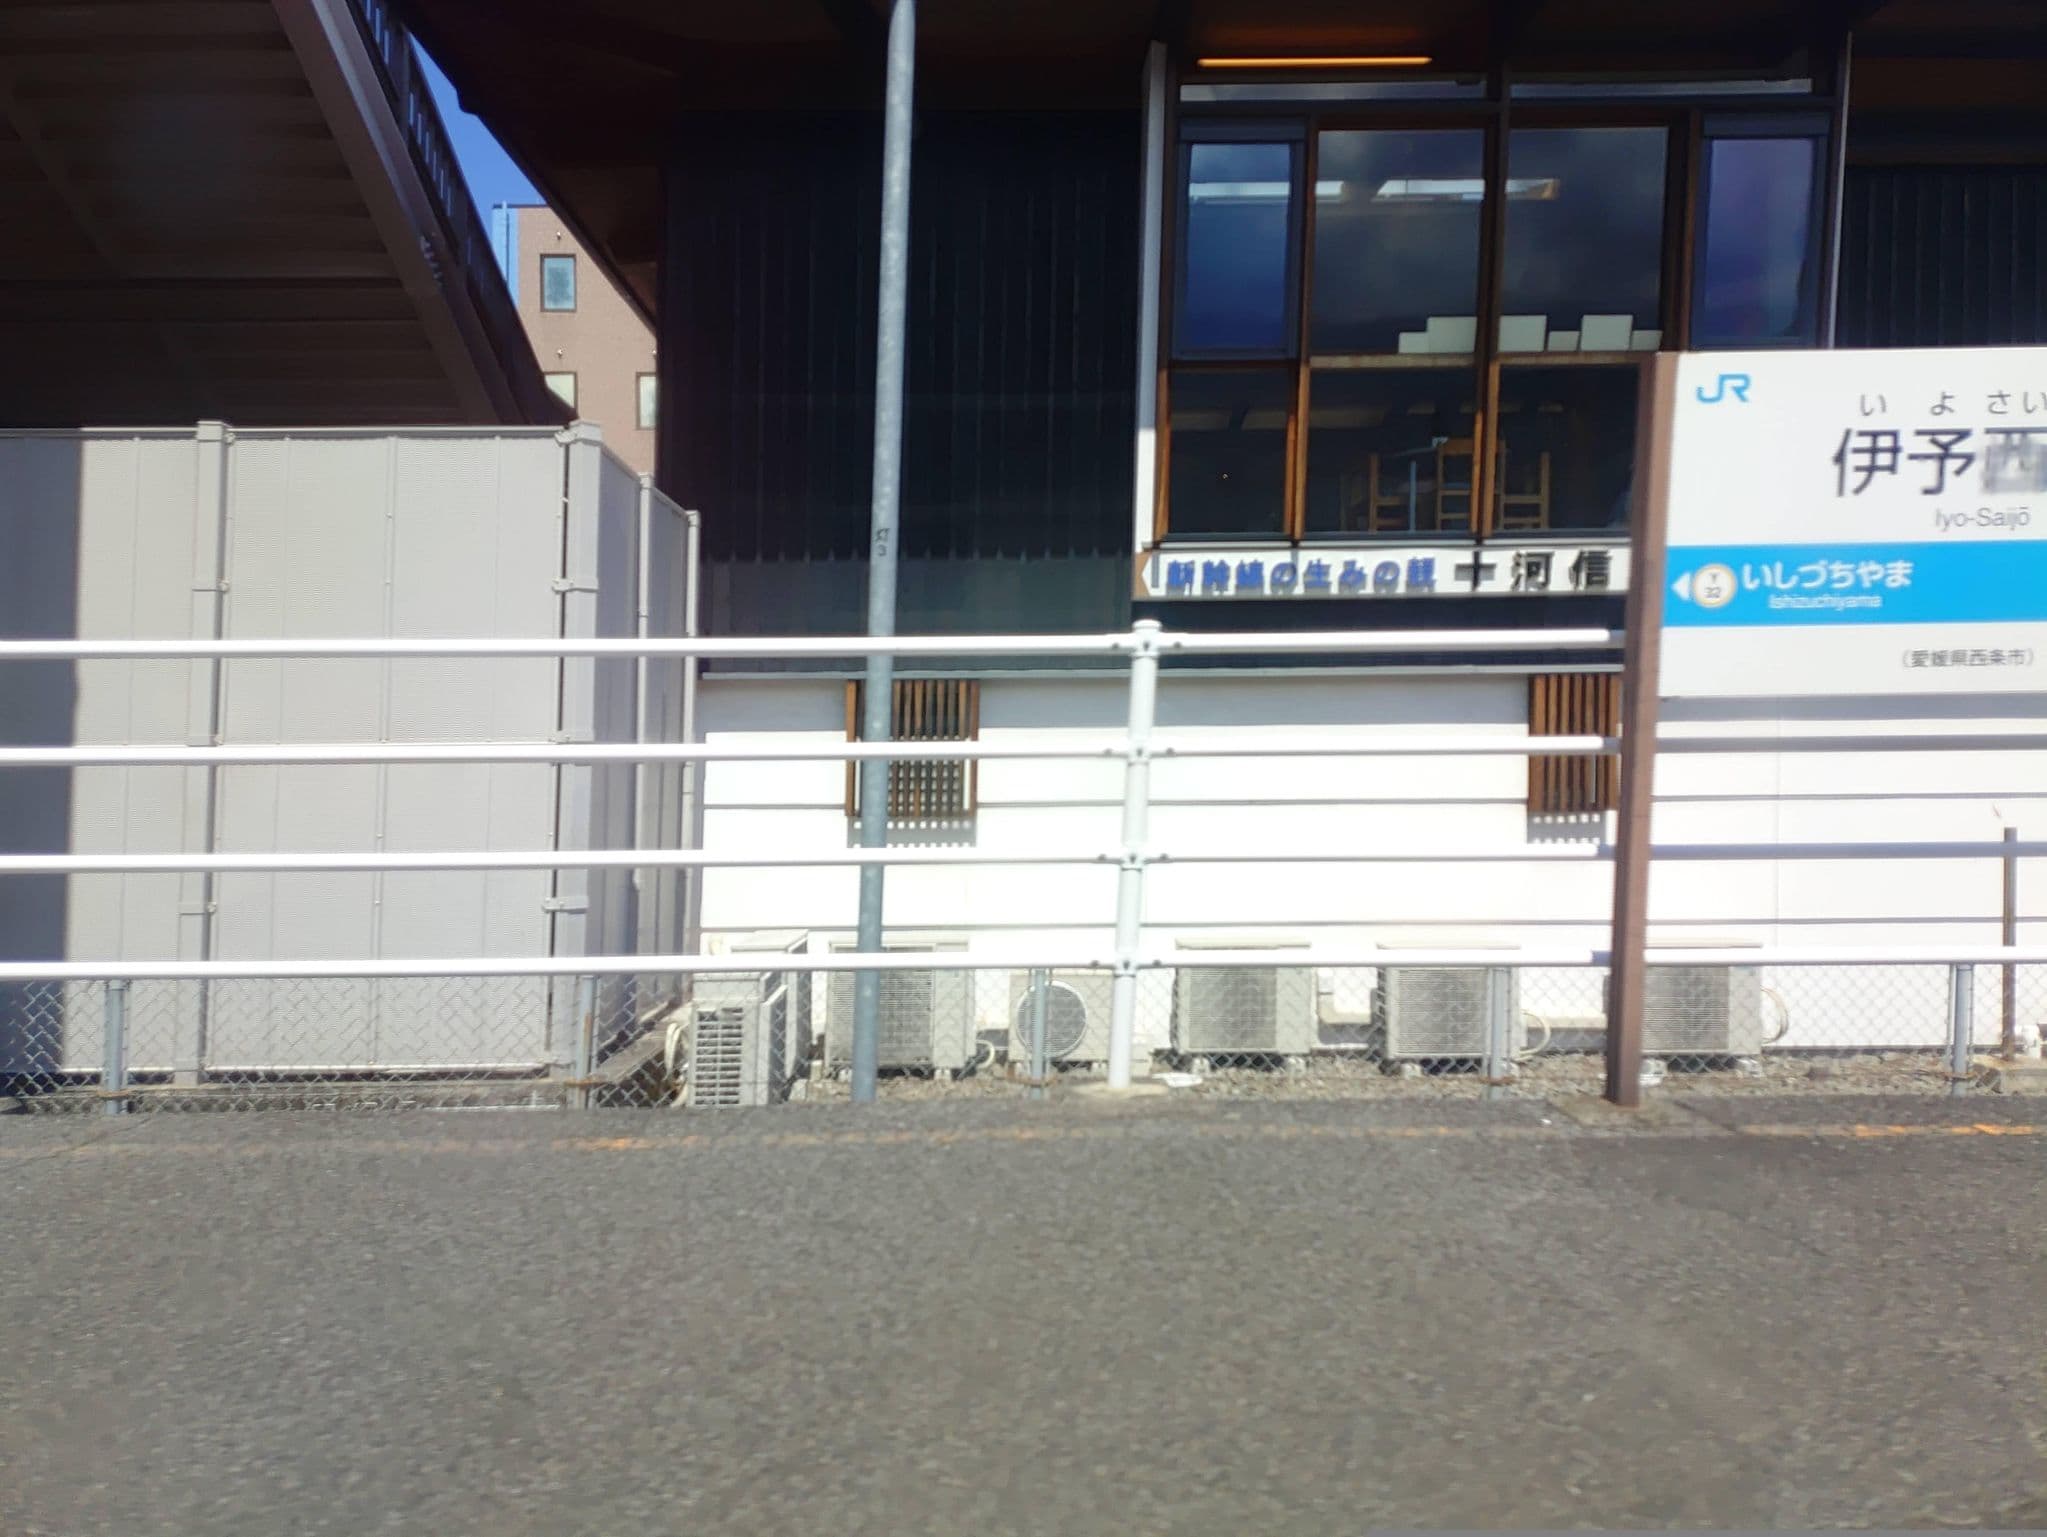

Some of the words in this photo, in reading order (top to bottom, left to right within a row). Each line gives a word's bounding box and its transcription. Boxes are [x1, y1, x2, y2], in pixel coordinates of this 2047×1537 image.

[1696, 373, 1751, 403] JR
[1742, 560, 1915, 590] いしづちやま
